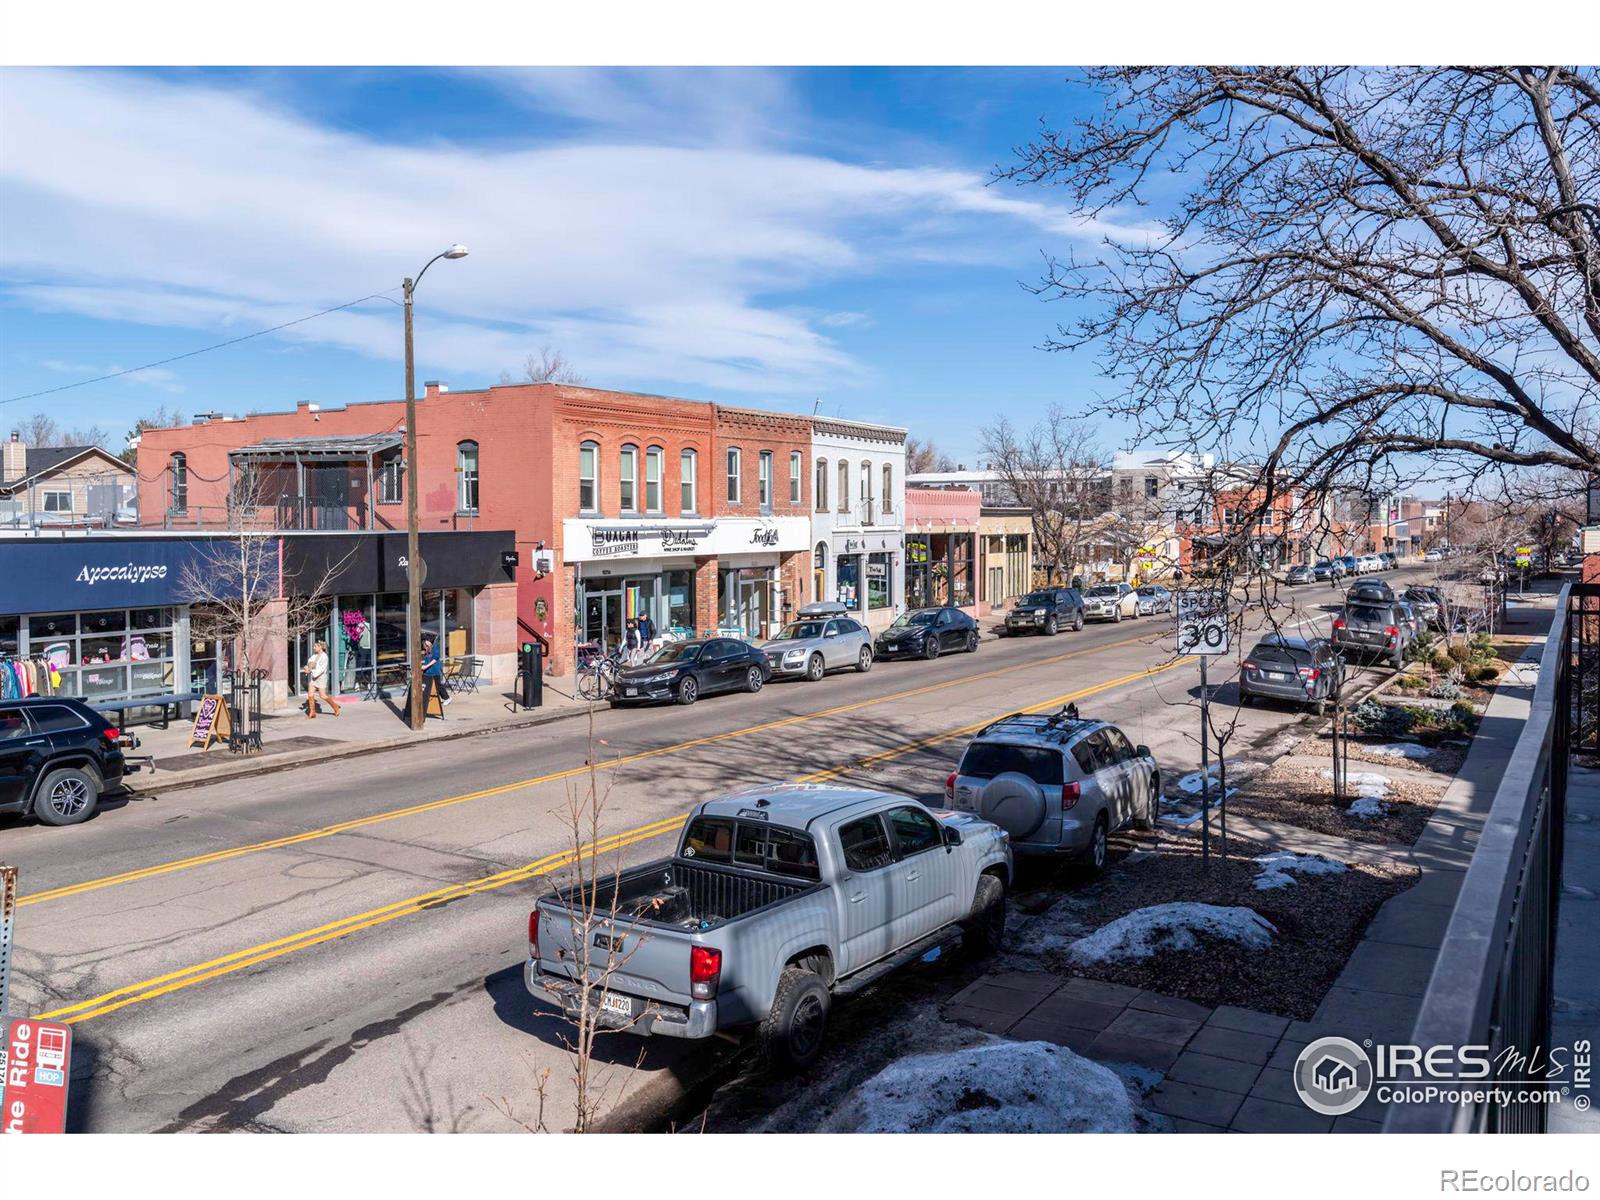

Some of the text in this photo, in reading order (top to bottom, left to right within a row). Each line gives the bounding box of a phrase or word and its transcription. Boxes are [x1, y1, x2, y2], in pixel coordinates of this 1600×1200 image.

[592, 546, 612, 556] COFFEE
[76, 563, 168, 585] Apocalypse
[1183, 624, 1223, 647] 30
[5, 1024, 31, 1134] he Ride
[39, 1071, 60, 1083] HOP
